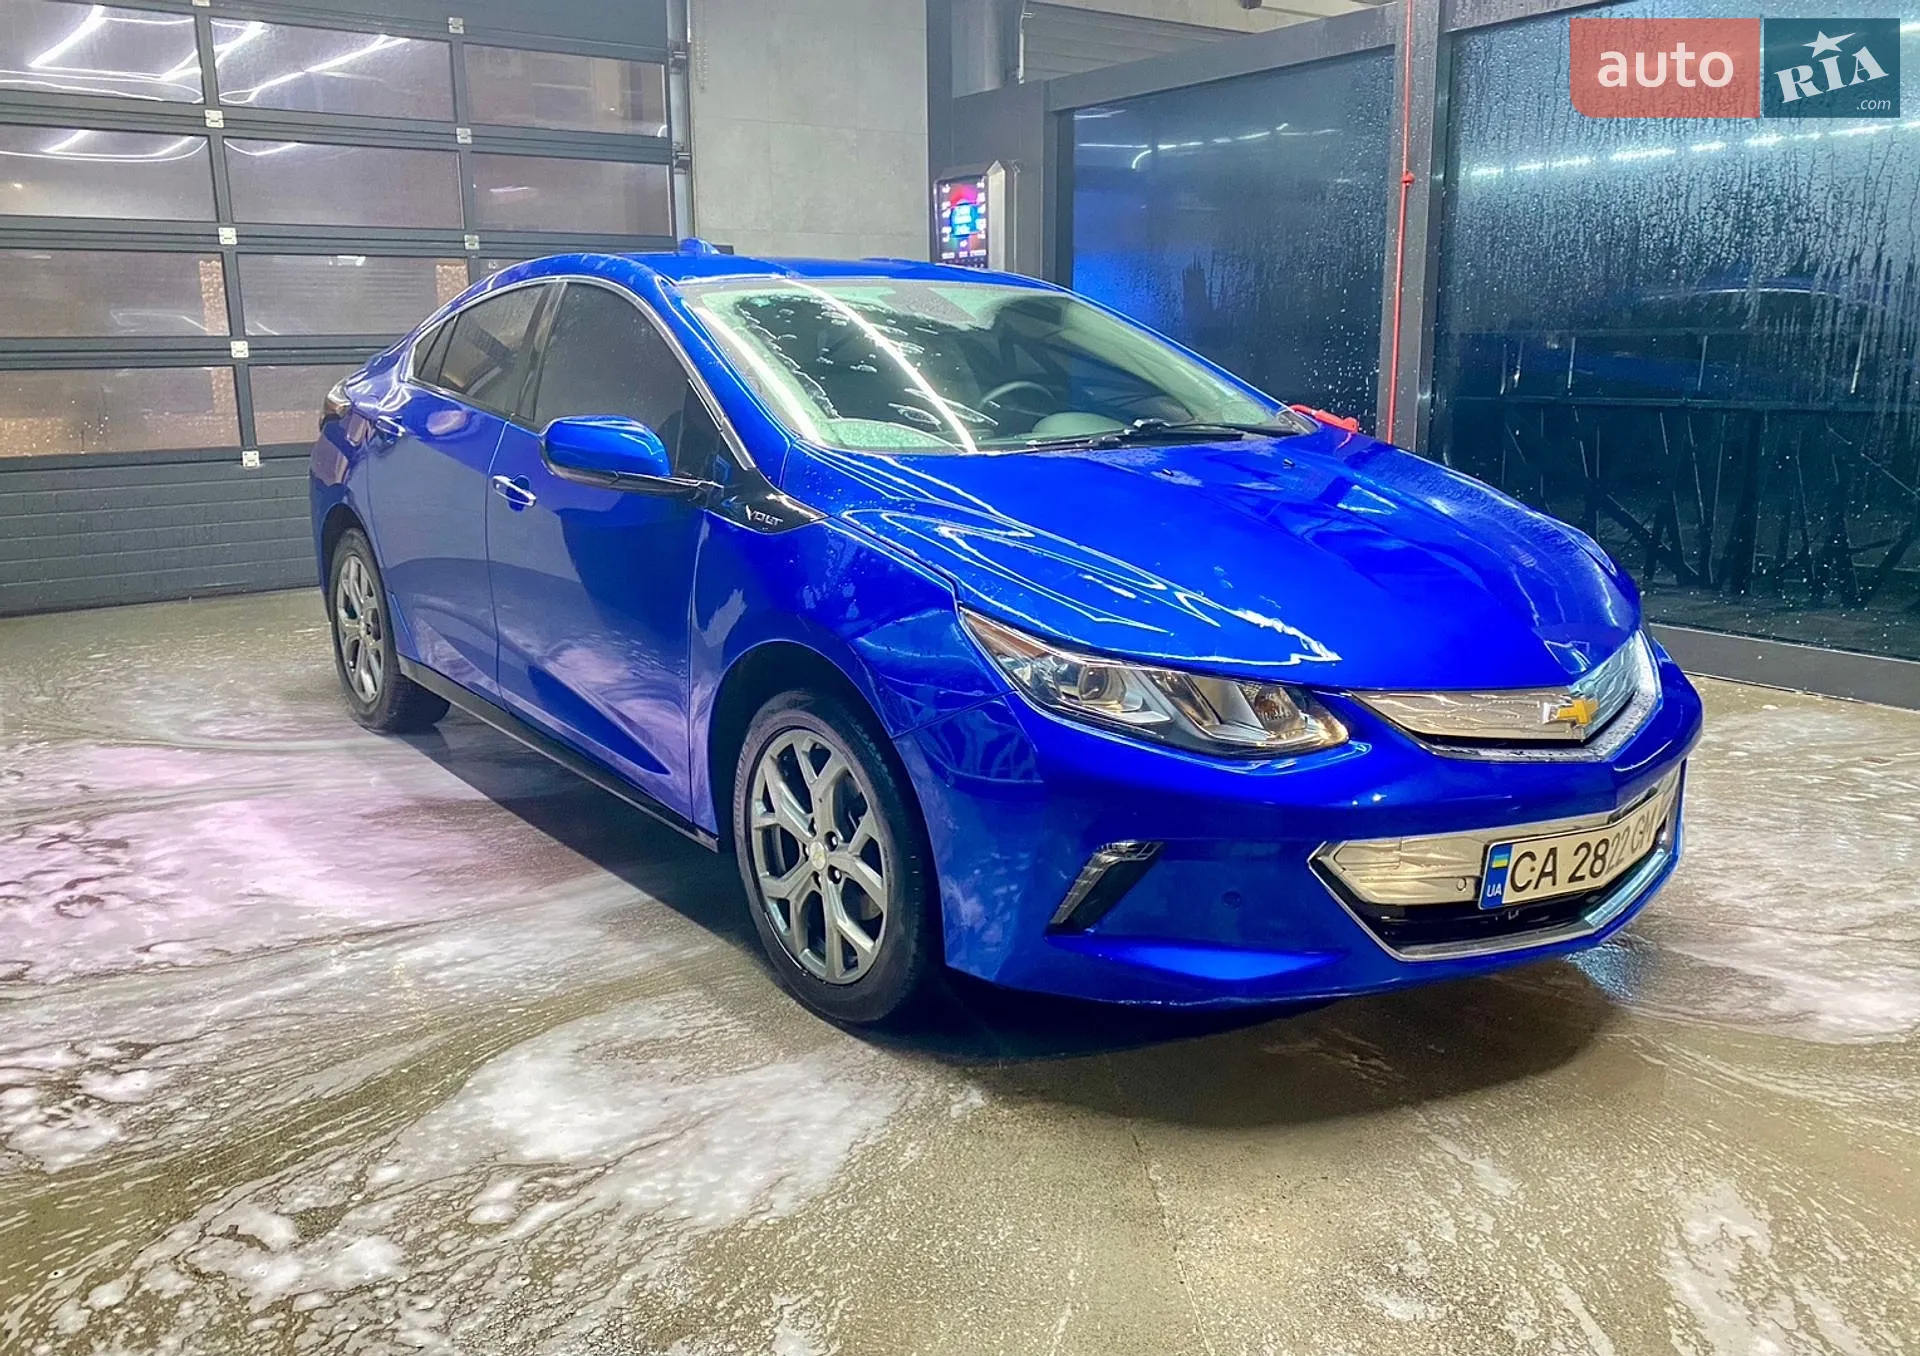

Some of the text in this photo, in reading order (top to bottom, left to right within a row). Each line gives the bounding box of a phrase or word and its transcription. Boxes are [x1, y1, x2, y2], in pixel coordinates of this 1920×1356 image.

[746, 504, 783, 526] VOLT
[1510, 846, 1558, 893] CA
[1567, 826, 1629, 884] 2822
[1486, 883, 1502, 898] UA
